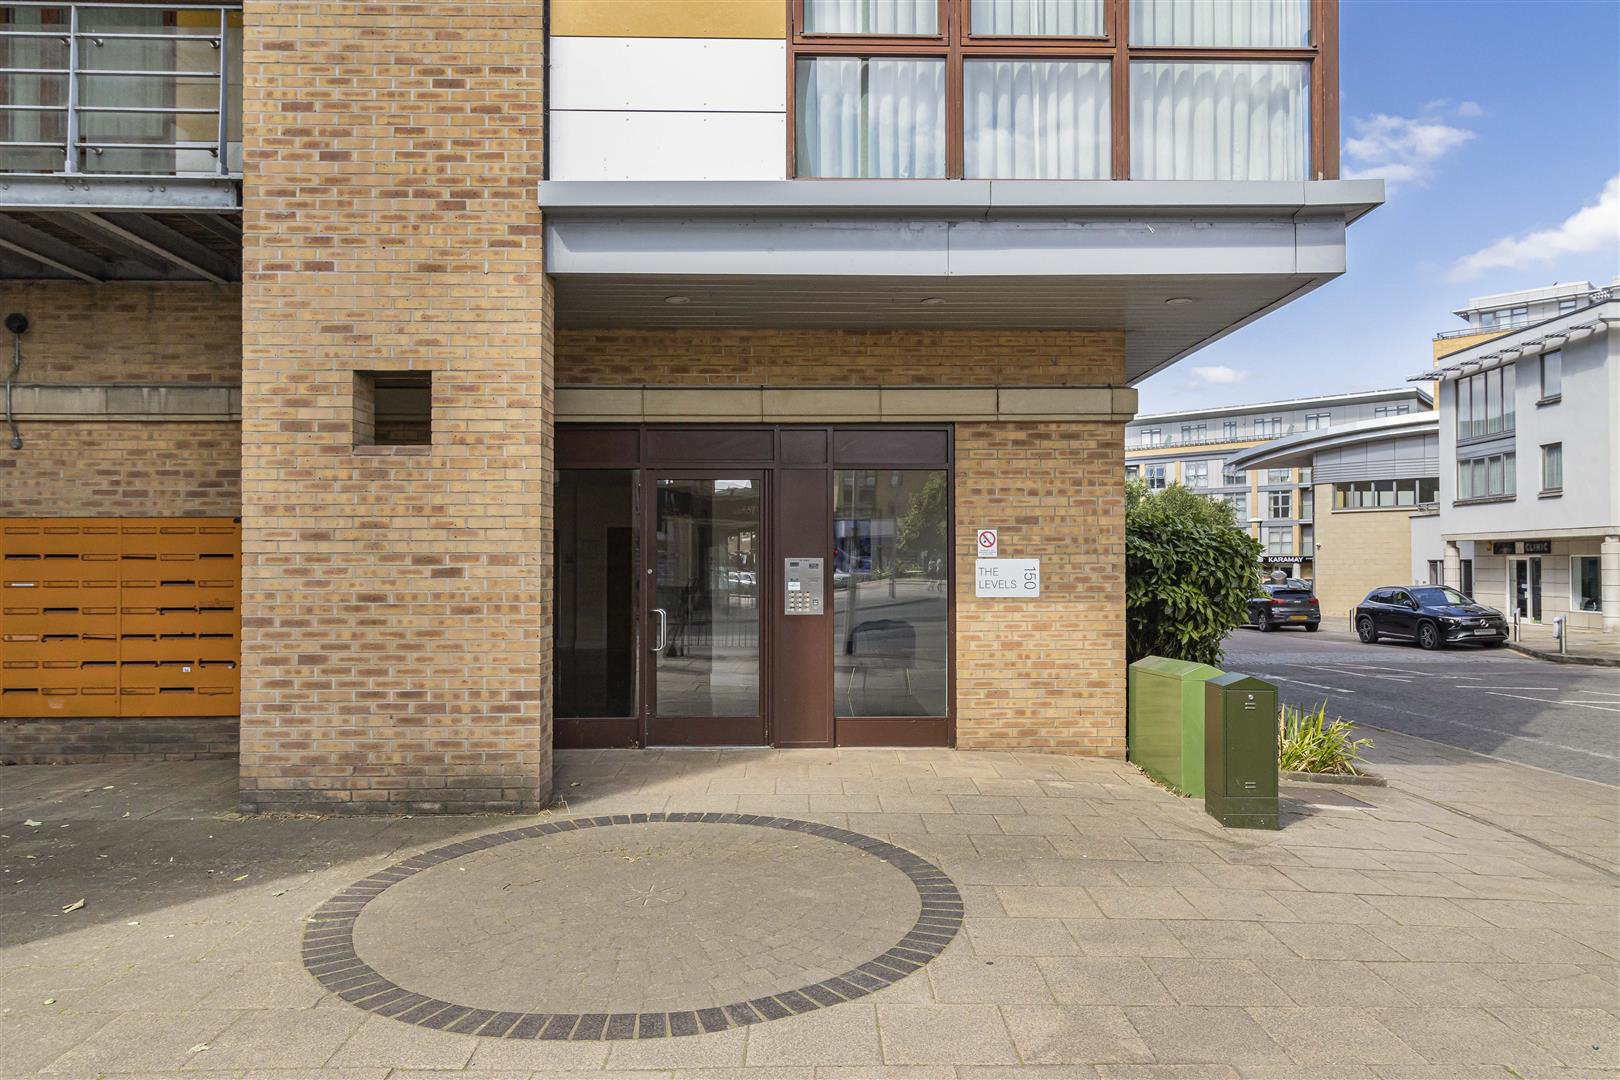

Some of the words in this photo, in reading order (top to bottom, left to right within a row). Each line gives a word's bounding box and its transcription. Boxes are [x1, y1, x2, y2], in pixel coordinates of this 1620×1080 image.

[978, 567, 999, 577] THE
[1024, 566, 1037, 590] 150
[978, 579, 1017, 590] LEVELS
